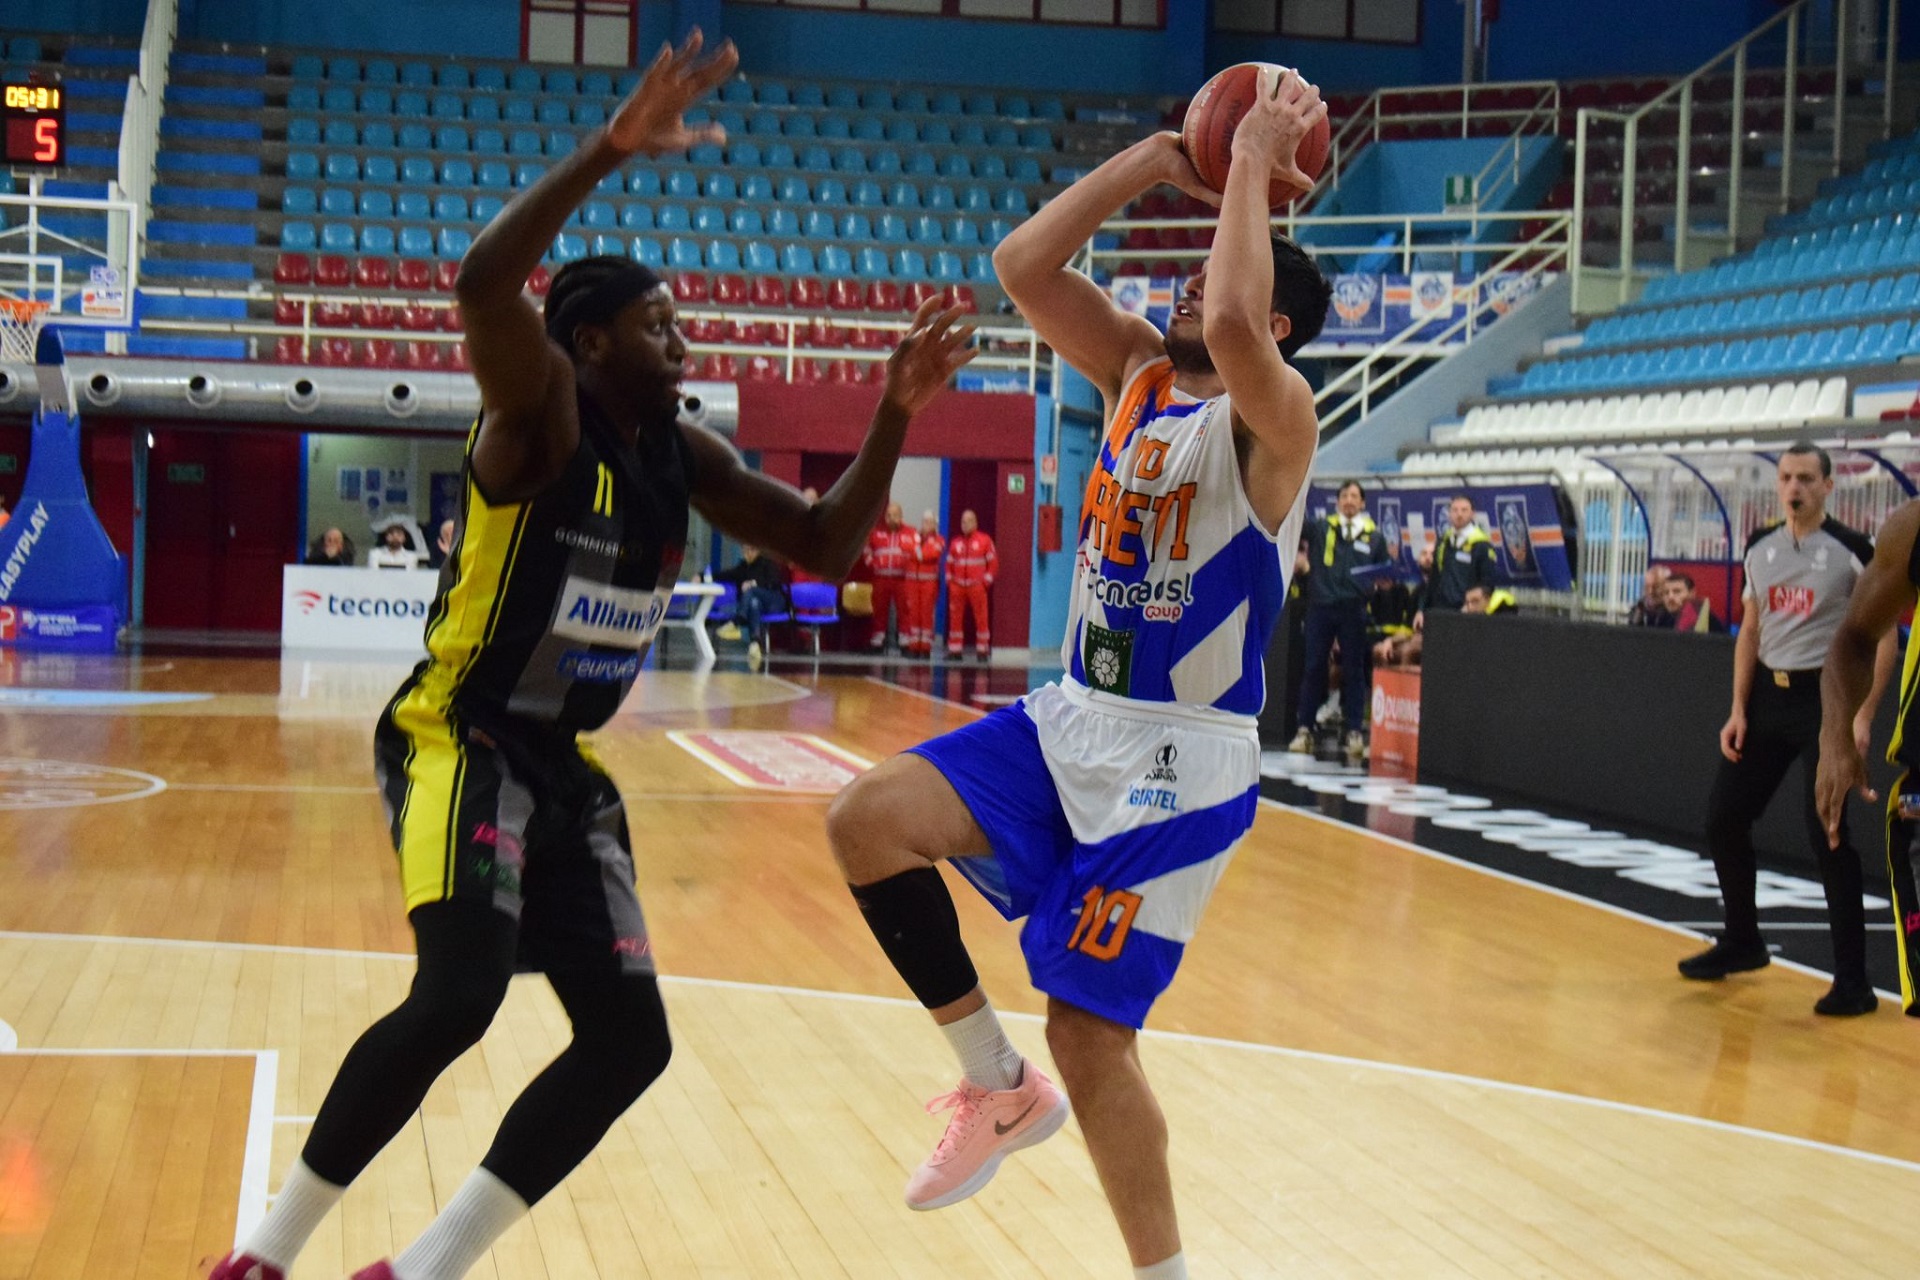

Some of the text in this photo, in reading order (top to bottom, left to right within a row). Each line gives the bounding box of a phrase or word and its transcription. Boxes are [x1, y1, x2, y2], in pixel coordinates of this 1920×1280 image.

[6, 86, 59, 109] 05:31
[34, 118, 57, 162] 5
[593, 461, 613, 518] 11
[0, 500, 49, 602] EASYPLAY
[1066, 884, 1143, 962] 10
